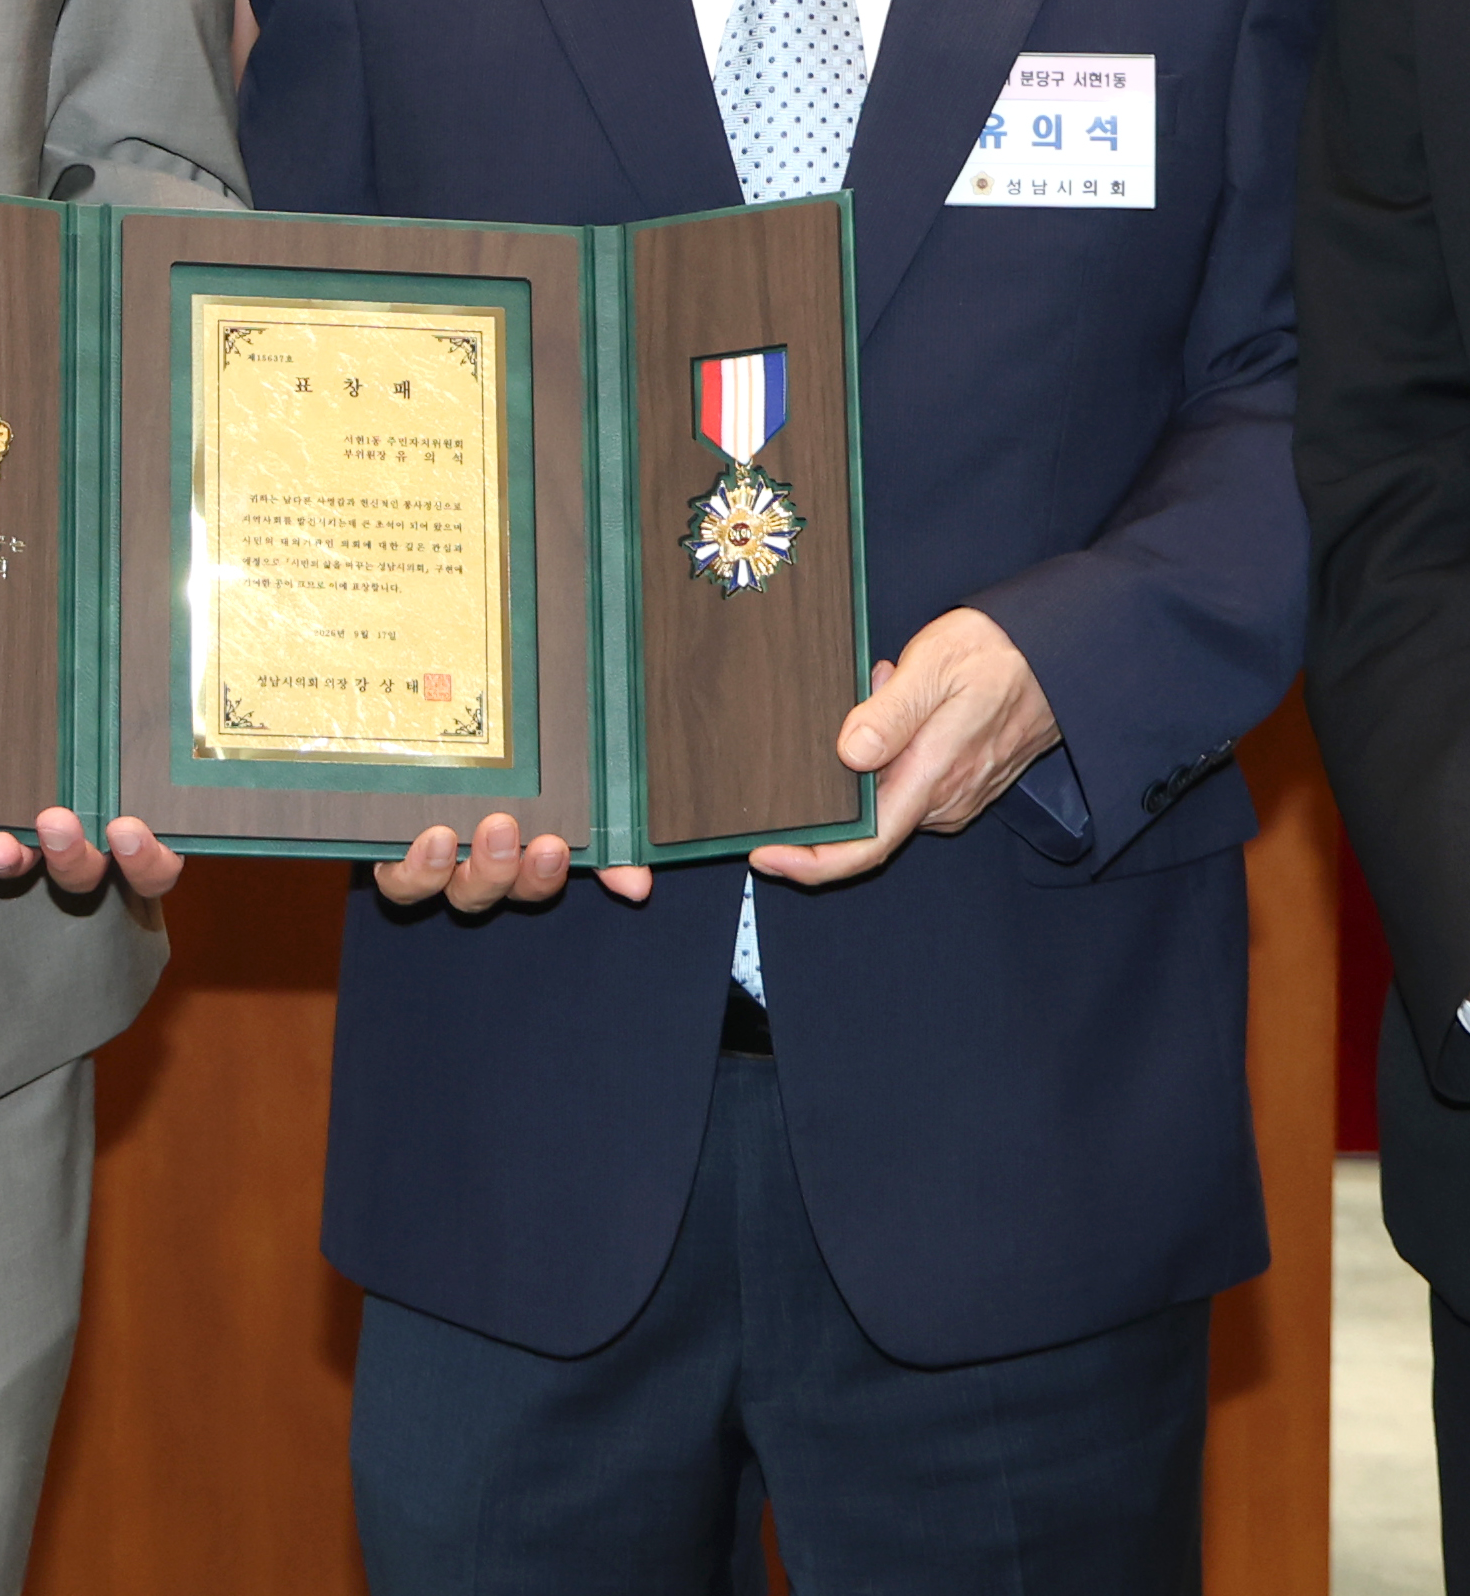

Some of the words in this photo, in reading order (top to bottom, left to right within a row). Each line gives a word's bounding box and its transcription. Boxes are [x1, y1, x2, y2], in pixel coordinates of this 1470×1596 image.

[1020, 70, 1065, 88] 분당구
[1073, 71, 1127, 89] 서현1동
[257, 675, 318, 689] 성남시의회
[324, 677, 348, 690] 의장
